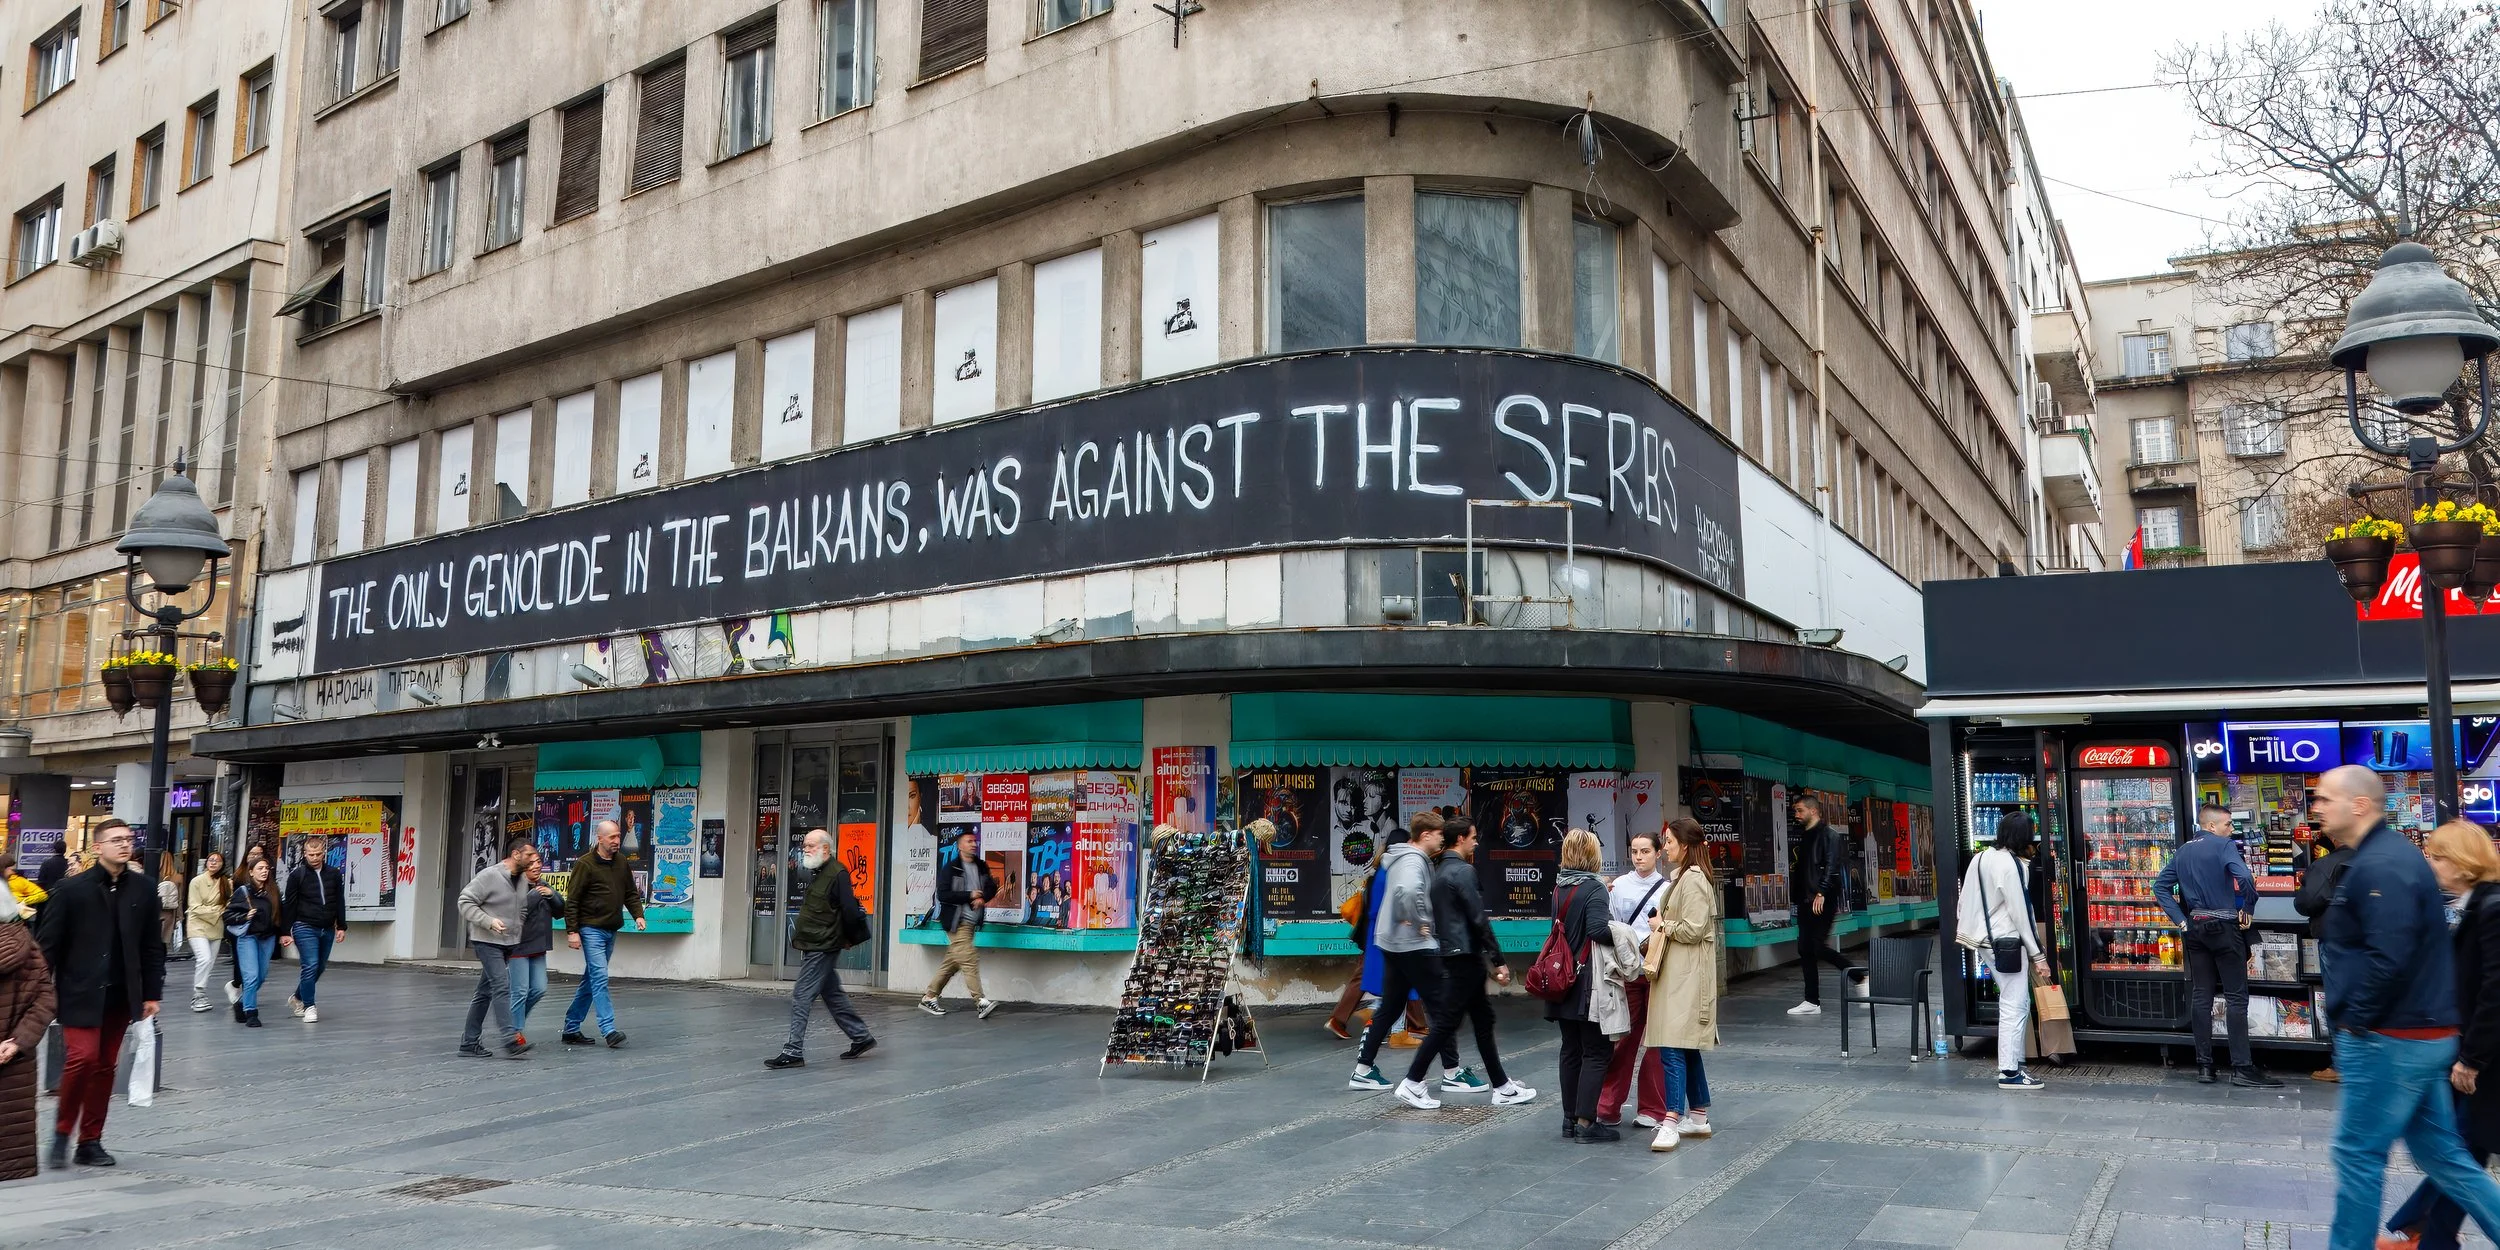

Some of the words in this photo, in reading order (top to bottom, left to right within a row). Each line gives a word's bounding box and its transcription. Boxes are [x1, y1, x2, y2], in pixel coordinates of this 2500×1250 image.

[328, 580, 377, 641] THE
[388, 561, 454, 631] ONLY
[464, 534, 612, 618] GENOCIDE
[625, 526, 652, 595] IN
[660, 514, 731, 589] THE
[744, 480, 928, 579] BALKANS,
[937, 455, 1022, 540] WAS
[1048, 411, 1261, 522] AGAINST
[1290, 397, 1464, 496] THE
[1494, 394, 1678, 534] SERBS
[2193, 739, 2224, 759] glo
[2249, 740, 2320, 763] HILO
[986, 783, 1025, 795] ЗВЕЗДА
[1253, 774, 1273, 789] GUNS
[1284, 774, 1315, 789] ROSES
[2463, 784, 2493, 805] glo
[983, 801, 1028, 811] СПАРТАК
[1703, 833, 1740, 842] ONNE
